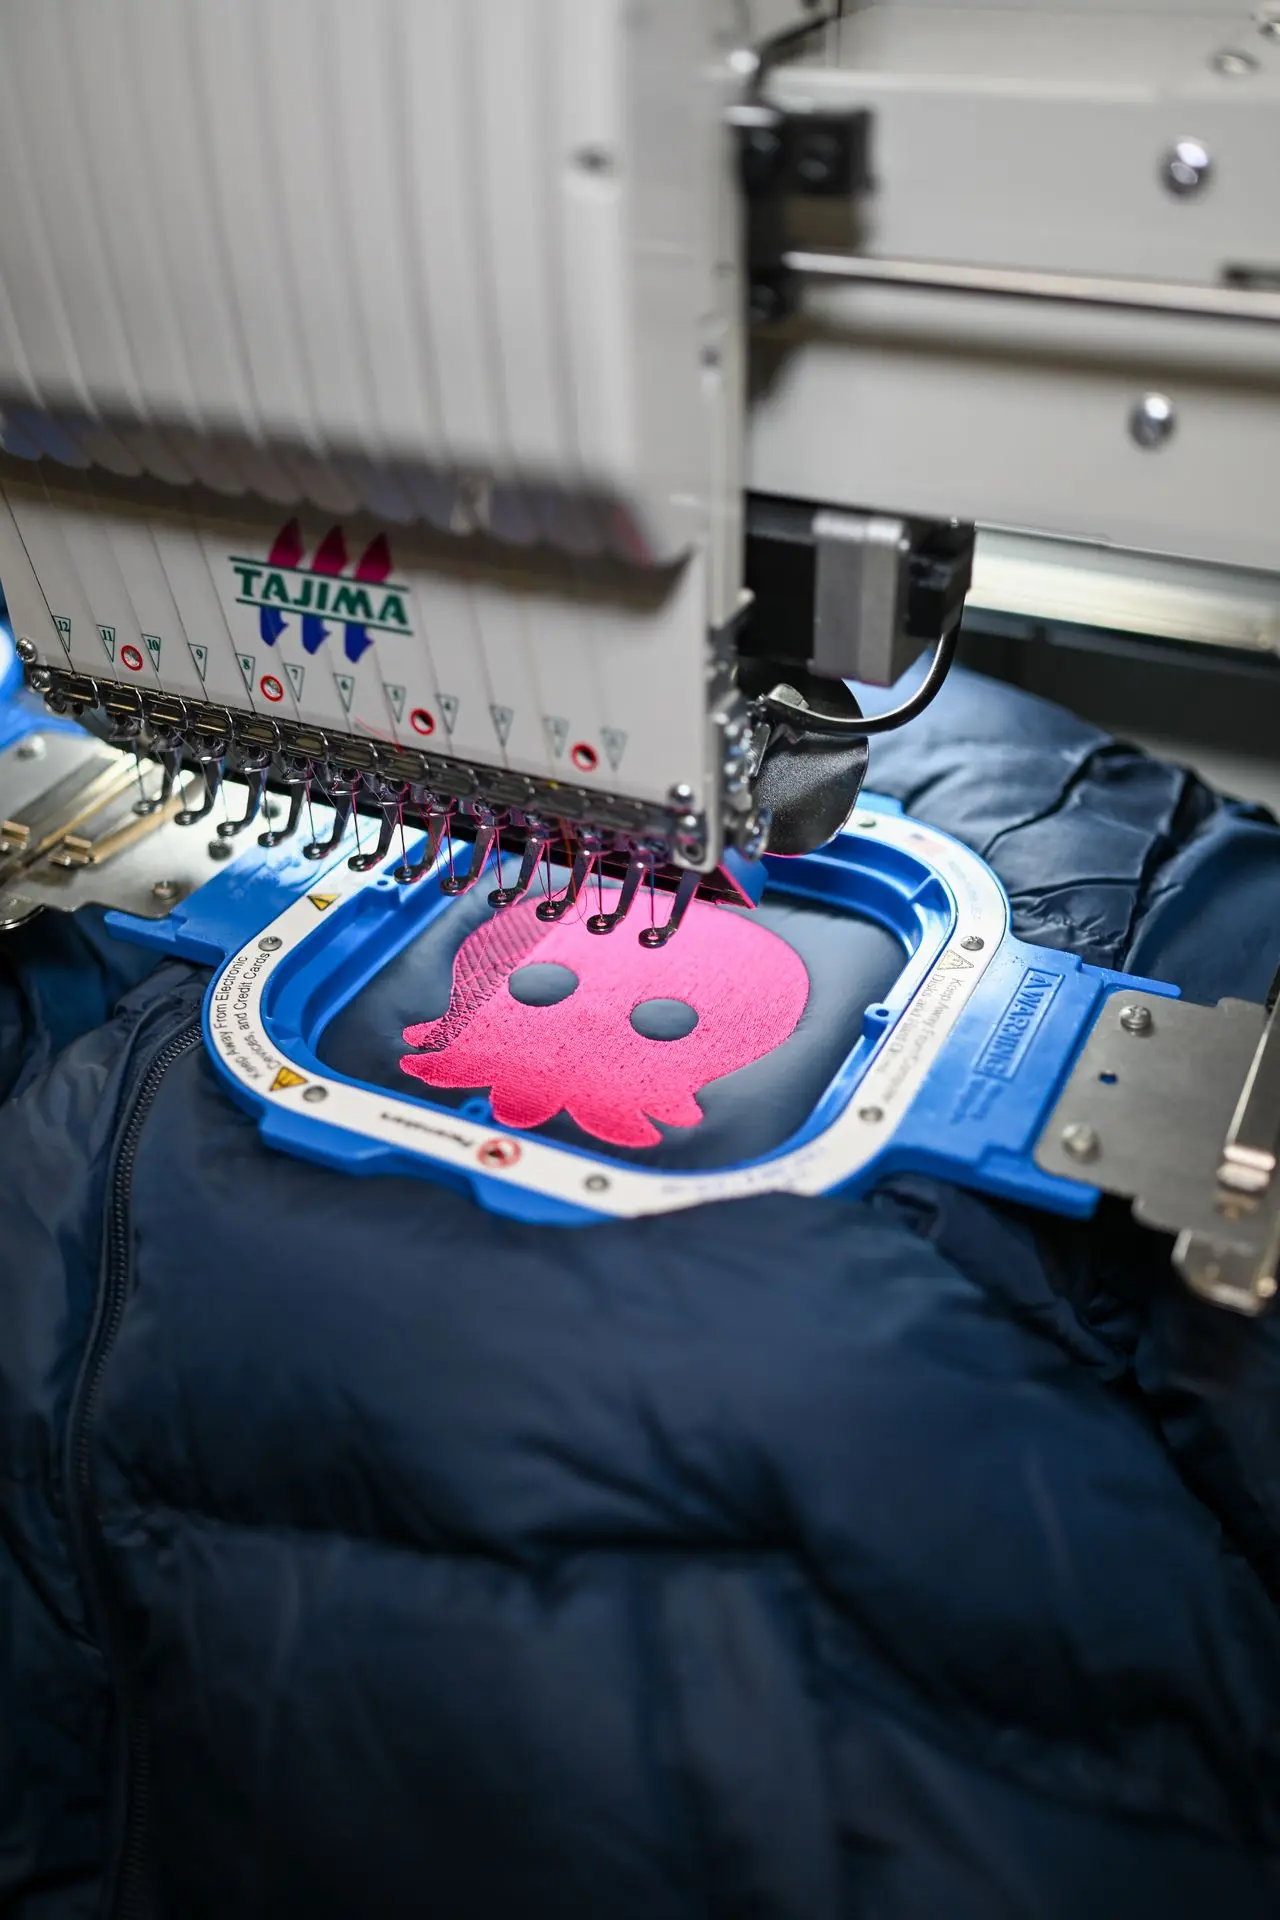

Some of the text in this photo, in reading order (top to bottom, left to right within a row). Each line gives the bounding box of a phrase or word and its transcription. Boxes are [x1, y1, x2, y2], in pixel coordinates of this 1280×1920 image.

[233, 566, 408, 625] TAJIMA
[57, 620, 70, 633] 12
[102, 629, 113, 642] 11
[147, 639, 160, 651] 10
[196, 649, 204, 660] 9
[242, 658, 250, 670] 8
[291, 668, 298, 680] 7
[243, 952, 270, 980] Cards
[233, 981, 253, 1010] Credit
[921, 973, 946, 997] Disks
[940, 977, 965, 1001] Keep
[213, 956, 264, 1080] Keep Away From Electronic
[233, 1012, 250, 1030] and
[983, 991, 1044, 1074] WARNING
